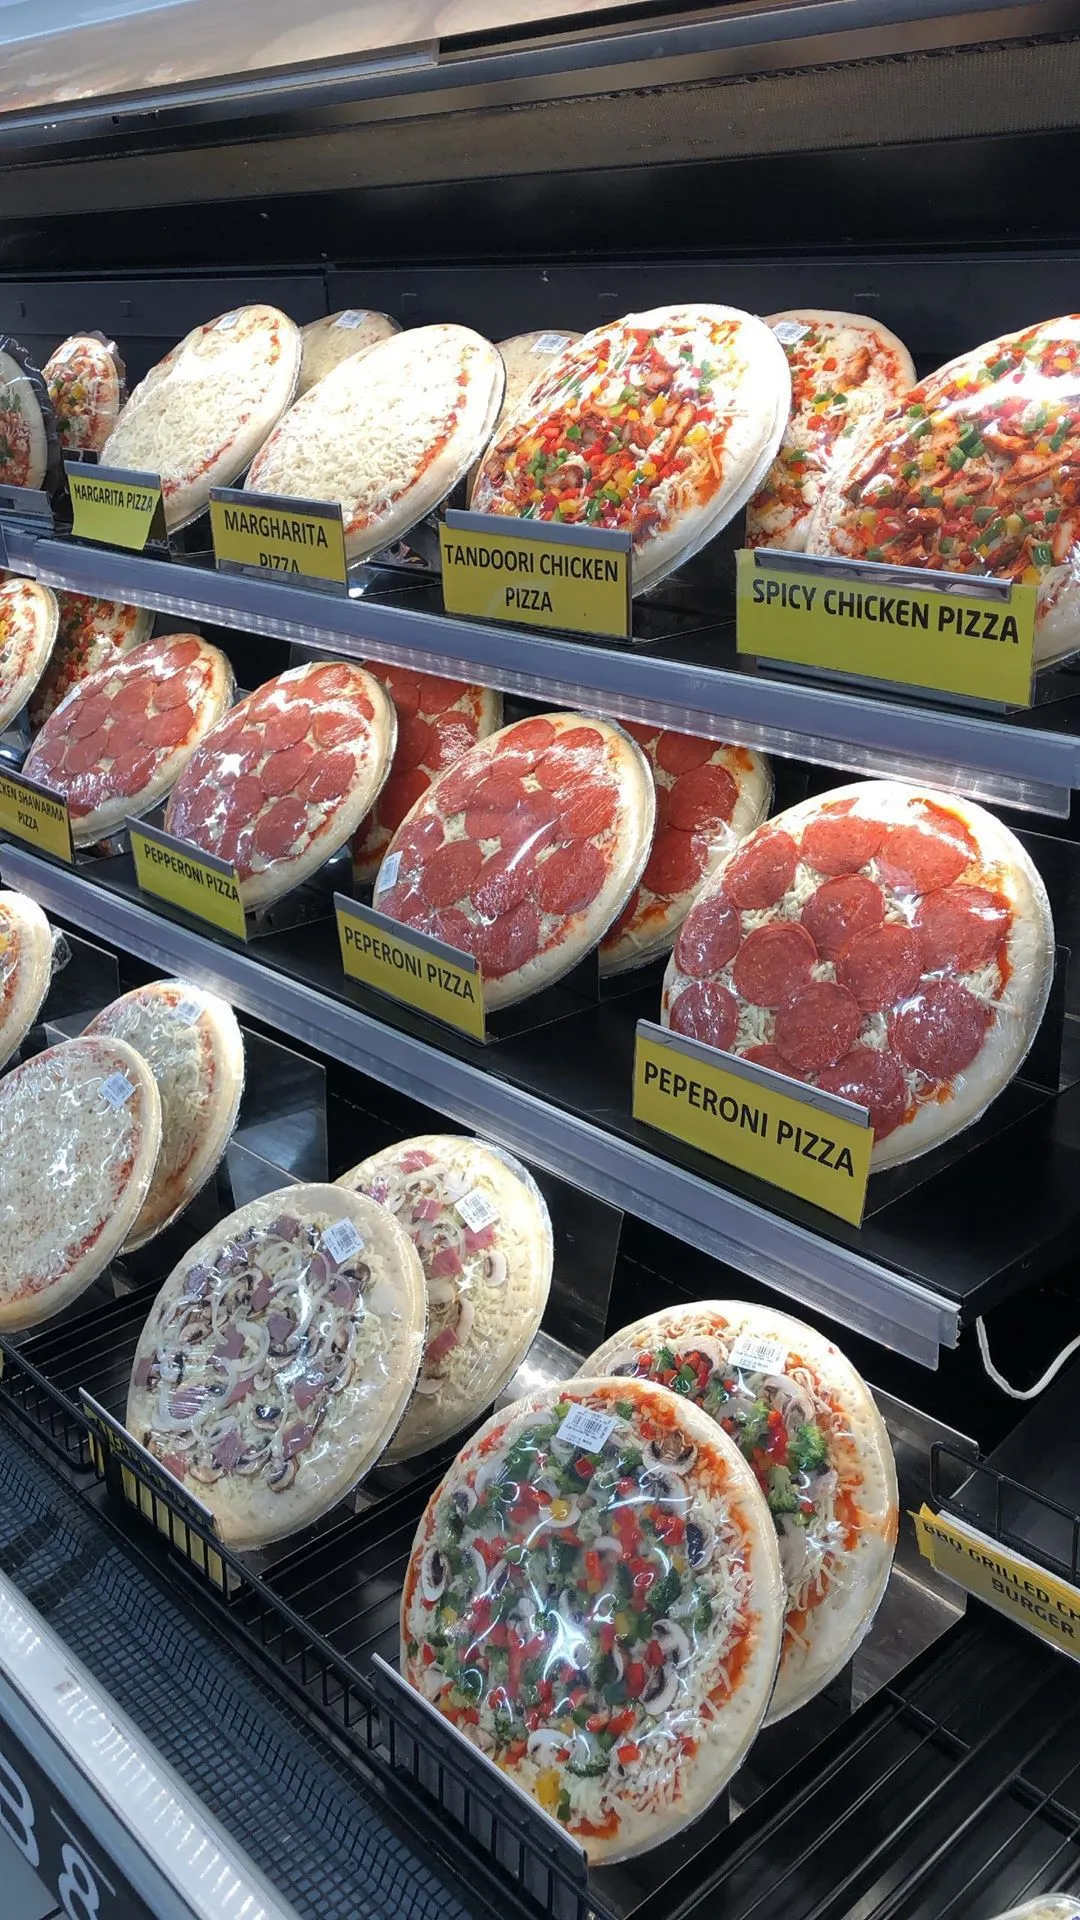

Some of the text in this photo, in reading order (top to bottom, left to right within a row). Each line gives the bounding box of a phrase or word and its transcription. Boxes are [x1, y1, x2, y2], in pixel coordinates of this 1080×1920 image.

[74, 483, 154, 513] MARGARITA PIZZA
[224, 509, 329, 548] MARGHARITA
[444, 544, 618, 582] TANDOORI CHICKEN
[505, 587, 553, 612] PIZZA
[752, 579, 1019, 644] SPICY CHICKEN PIZZA
[18, 811, 39, 832] PIZZA
[19, 790, 65, 823] SHAWARMA
[144, 844, 240, 903] PEPPERONI PIZZA
[344, 926, 475, 1003] PEPERONI PIZZA
[644, 1061, 855, 1178] PEPERONI PIZZA
[969, 1548, 1049, 1603] GRILLED
[992, 1577, 1076, 1639] BURGER
